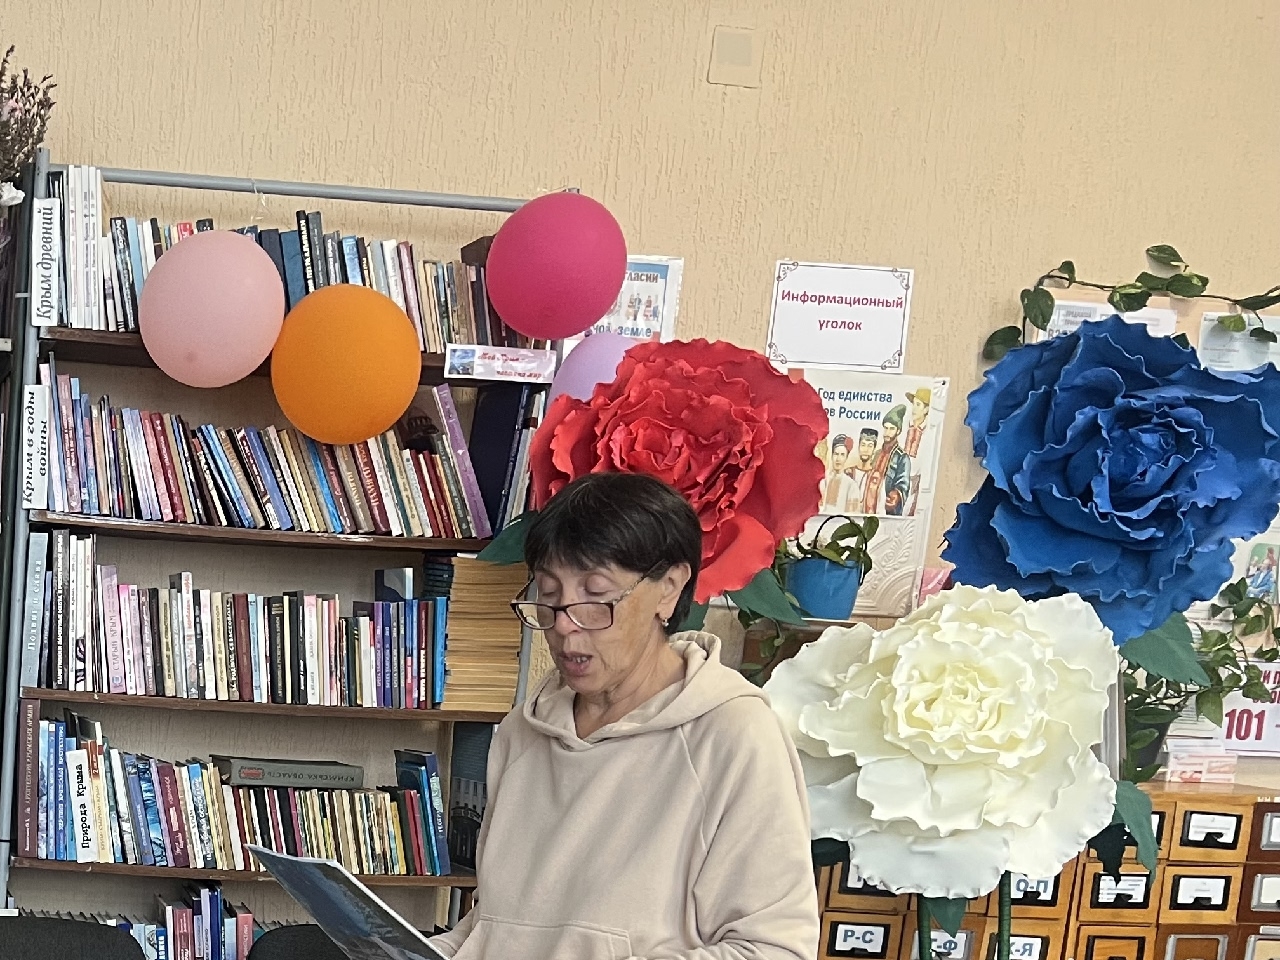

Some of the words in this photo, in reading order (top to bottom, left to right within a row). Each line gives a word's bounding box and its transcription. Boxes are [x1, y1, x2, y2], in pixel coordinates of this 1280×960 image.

[37, 205, 58, 270] древний
[36, 272, 53, 320] Крым
[782, 290, 903, 309] Информационный
[818, 319, 862, 330] уголок
[25, 391, 36, 433] годы
[818, 388, 835, 400] Год
[838, 390, 892, 403] единства
[839, 406, 881, 420] России
[36, 420, 48, 477] войны
[21, 453, 36, 503] Крым
[1225, 708, 1266, 741] 101
[74, 764, 85, 797] Крыма
[79, 803, 91, 849] Природа
[1015, 878, 1049, 894] О-П
[843, 929, 875, 943] Р-С
